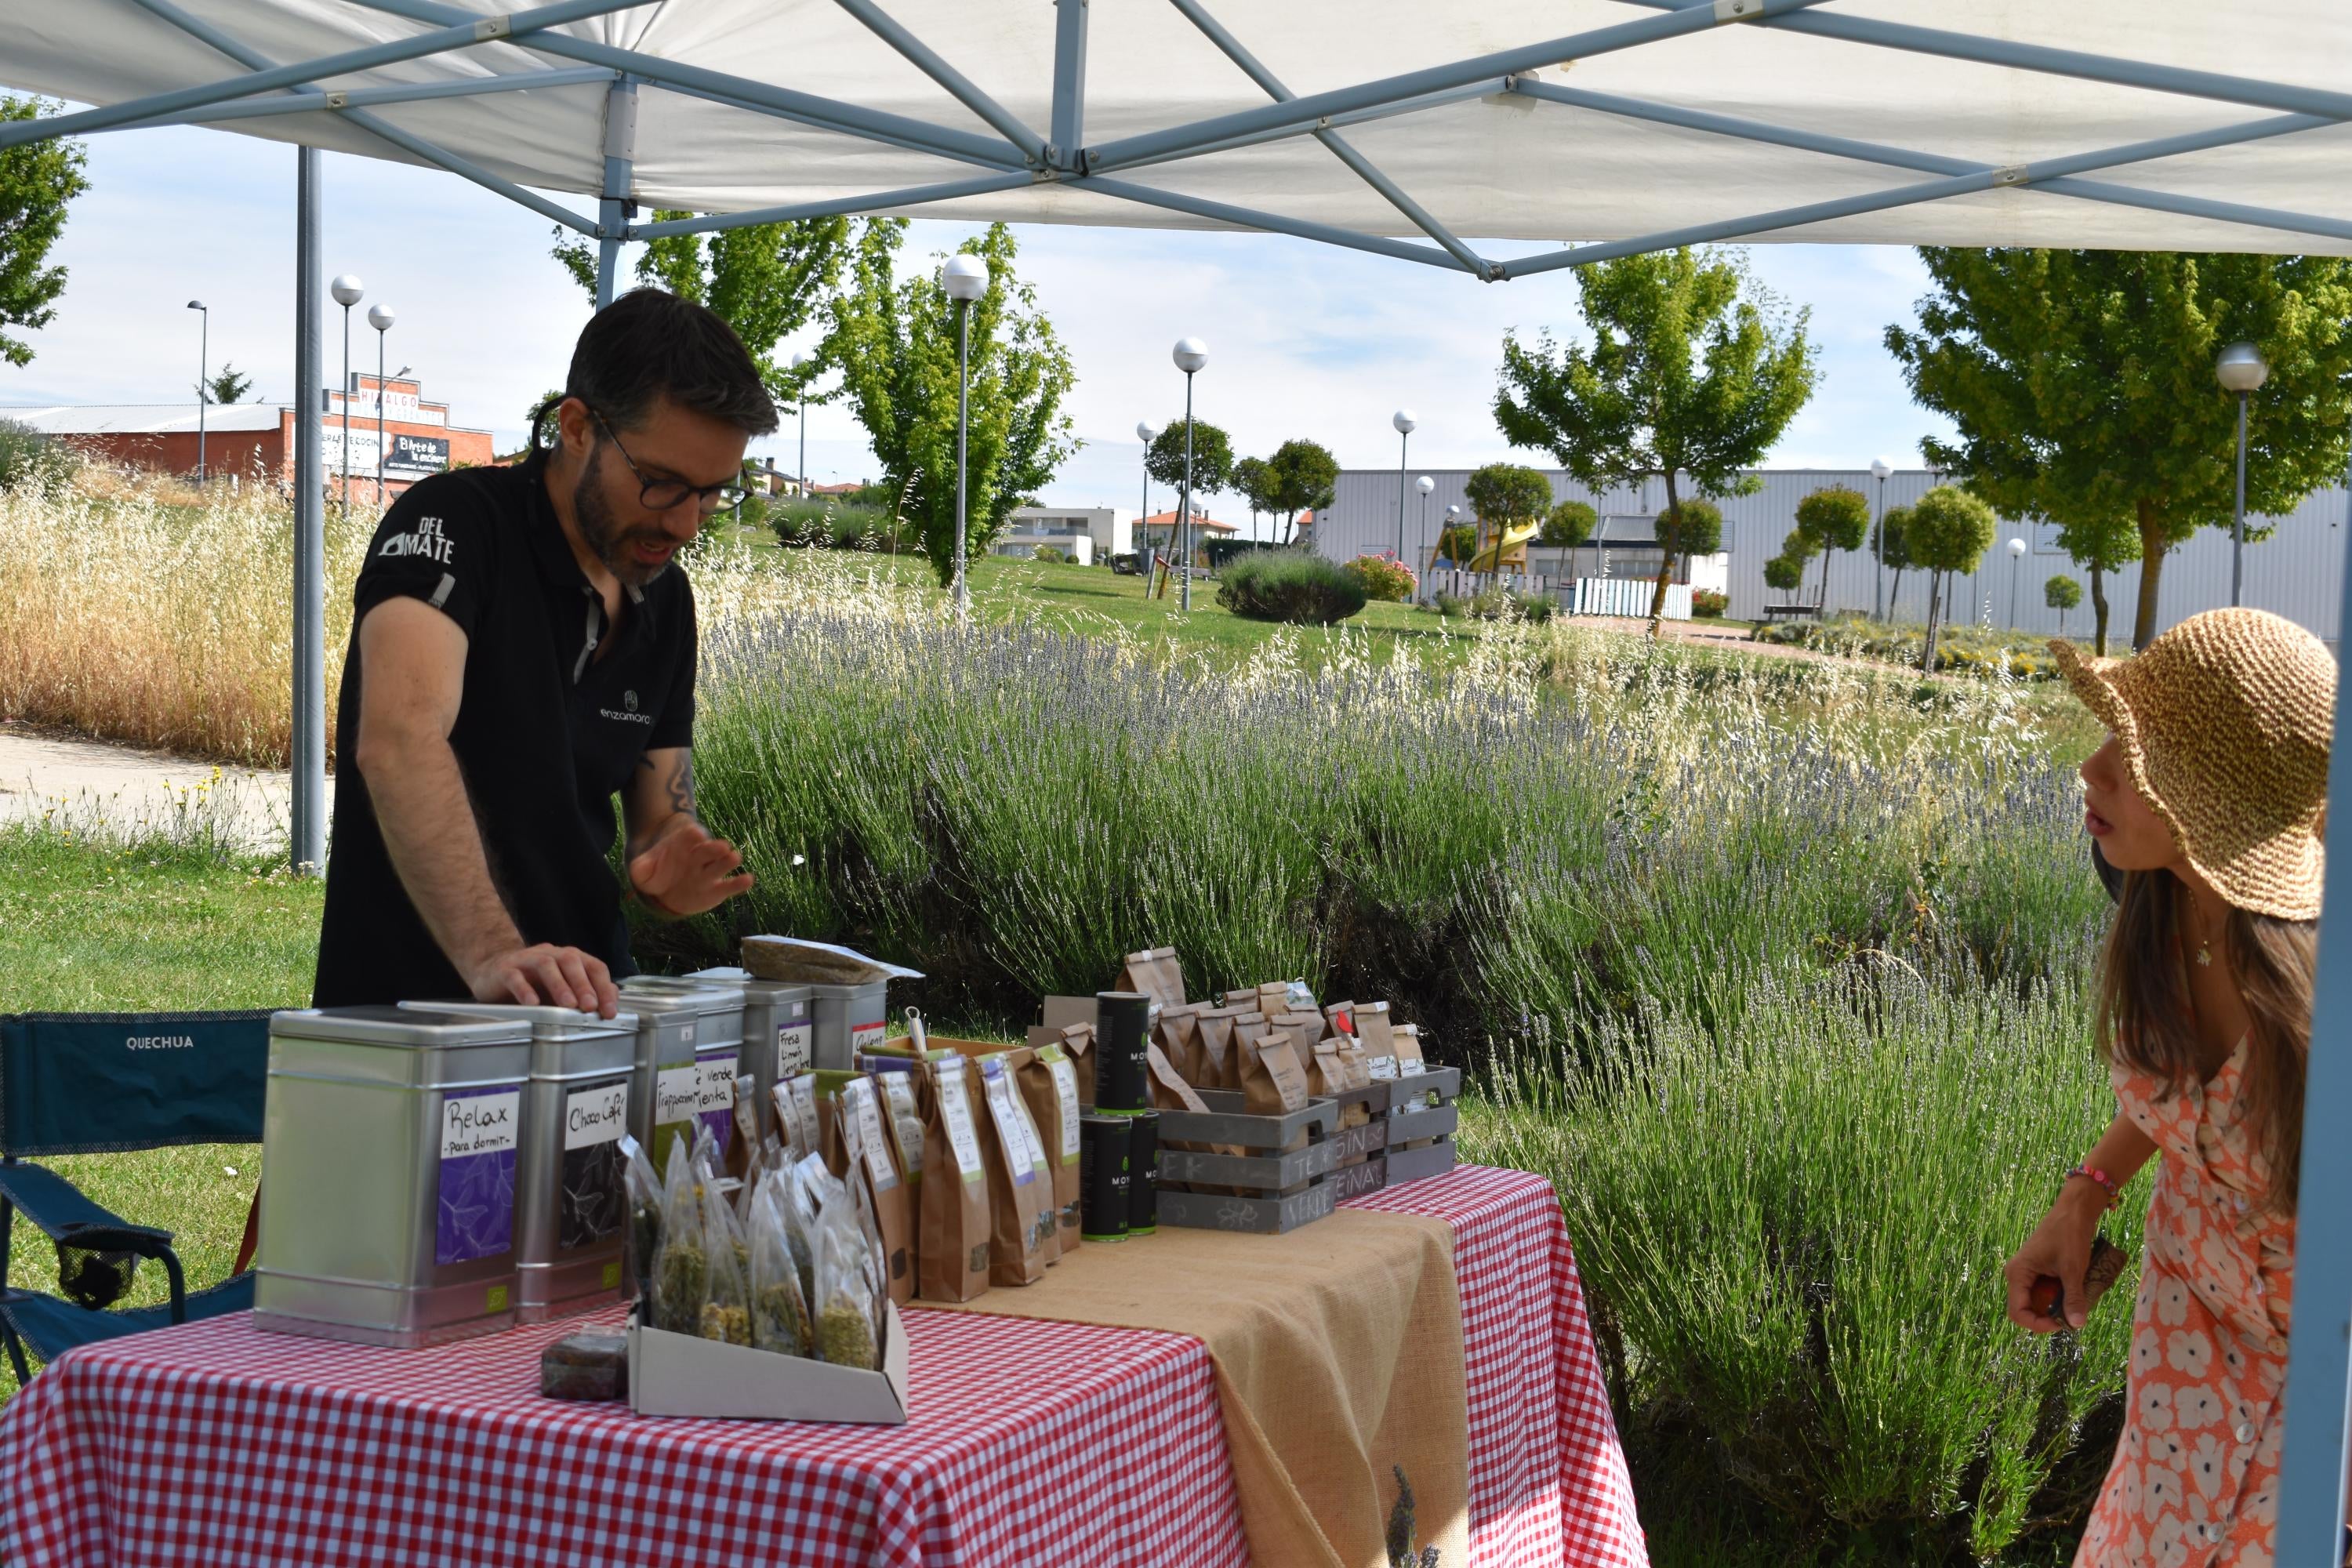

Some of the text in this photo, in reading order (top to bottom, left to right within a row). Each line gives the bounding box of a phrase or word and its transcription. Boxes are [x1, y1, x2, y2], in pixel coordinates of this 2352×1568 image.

[361, 390, 416, 407] HIALGO
[355, 437, 379, 448] COCIN
[399, 437, 437, 454] El Arte de
[419, 517, 445, 537] DEL
[404, 534, 455, 564] MATE
[126, 1036, 194, 1051] QUECHUA
[780, 1033, 800, 1045] Fresa
[601, 1093, 626, 1125] Café
[448, 1102, 509, 1138] Relax
